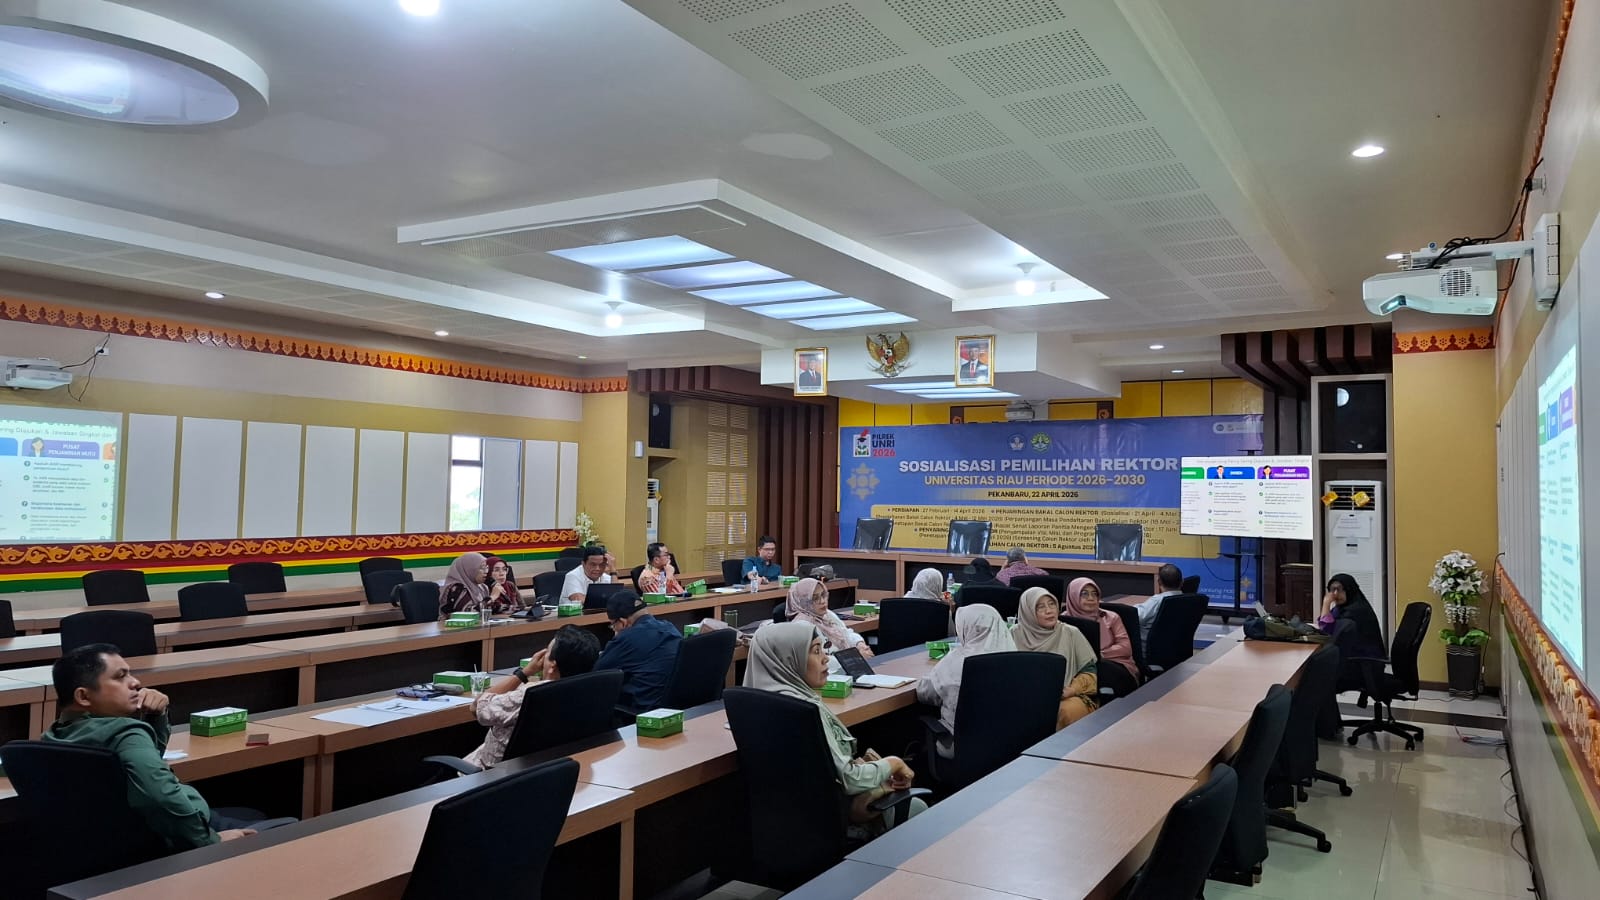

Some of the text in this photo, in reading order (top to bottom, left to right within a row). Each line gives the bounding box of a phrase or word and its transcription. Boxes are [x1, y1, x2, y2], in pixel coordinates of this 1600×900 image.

[872, 440, 895, 448] UNRI
[872, 449, 895, 457] 2026
[899, 457, 1178, 472] SOSIALISASI PEMILIHAN REKTOR
[924, 475, 994, 485] UNIVERSITAS
[996, 475, 1023, 485] RIAU
[1025, 475, 1075, 485] PERIODE
[988, 491, 1031, 499] PEKANBARU,
